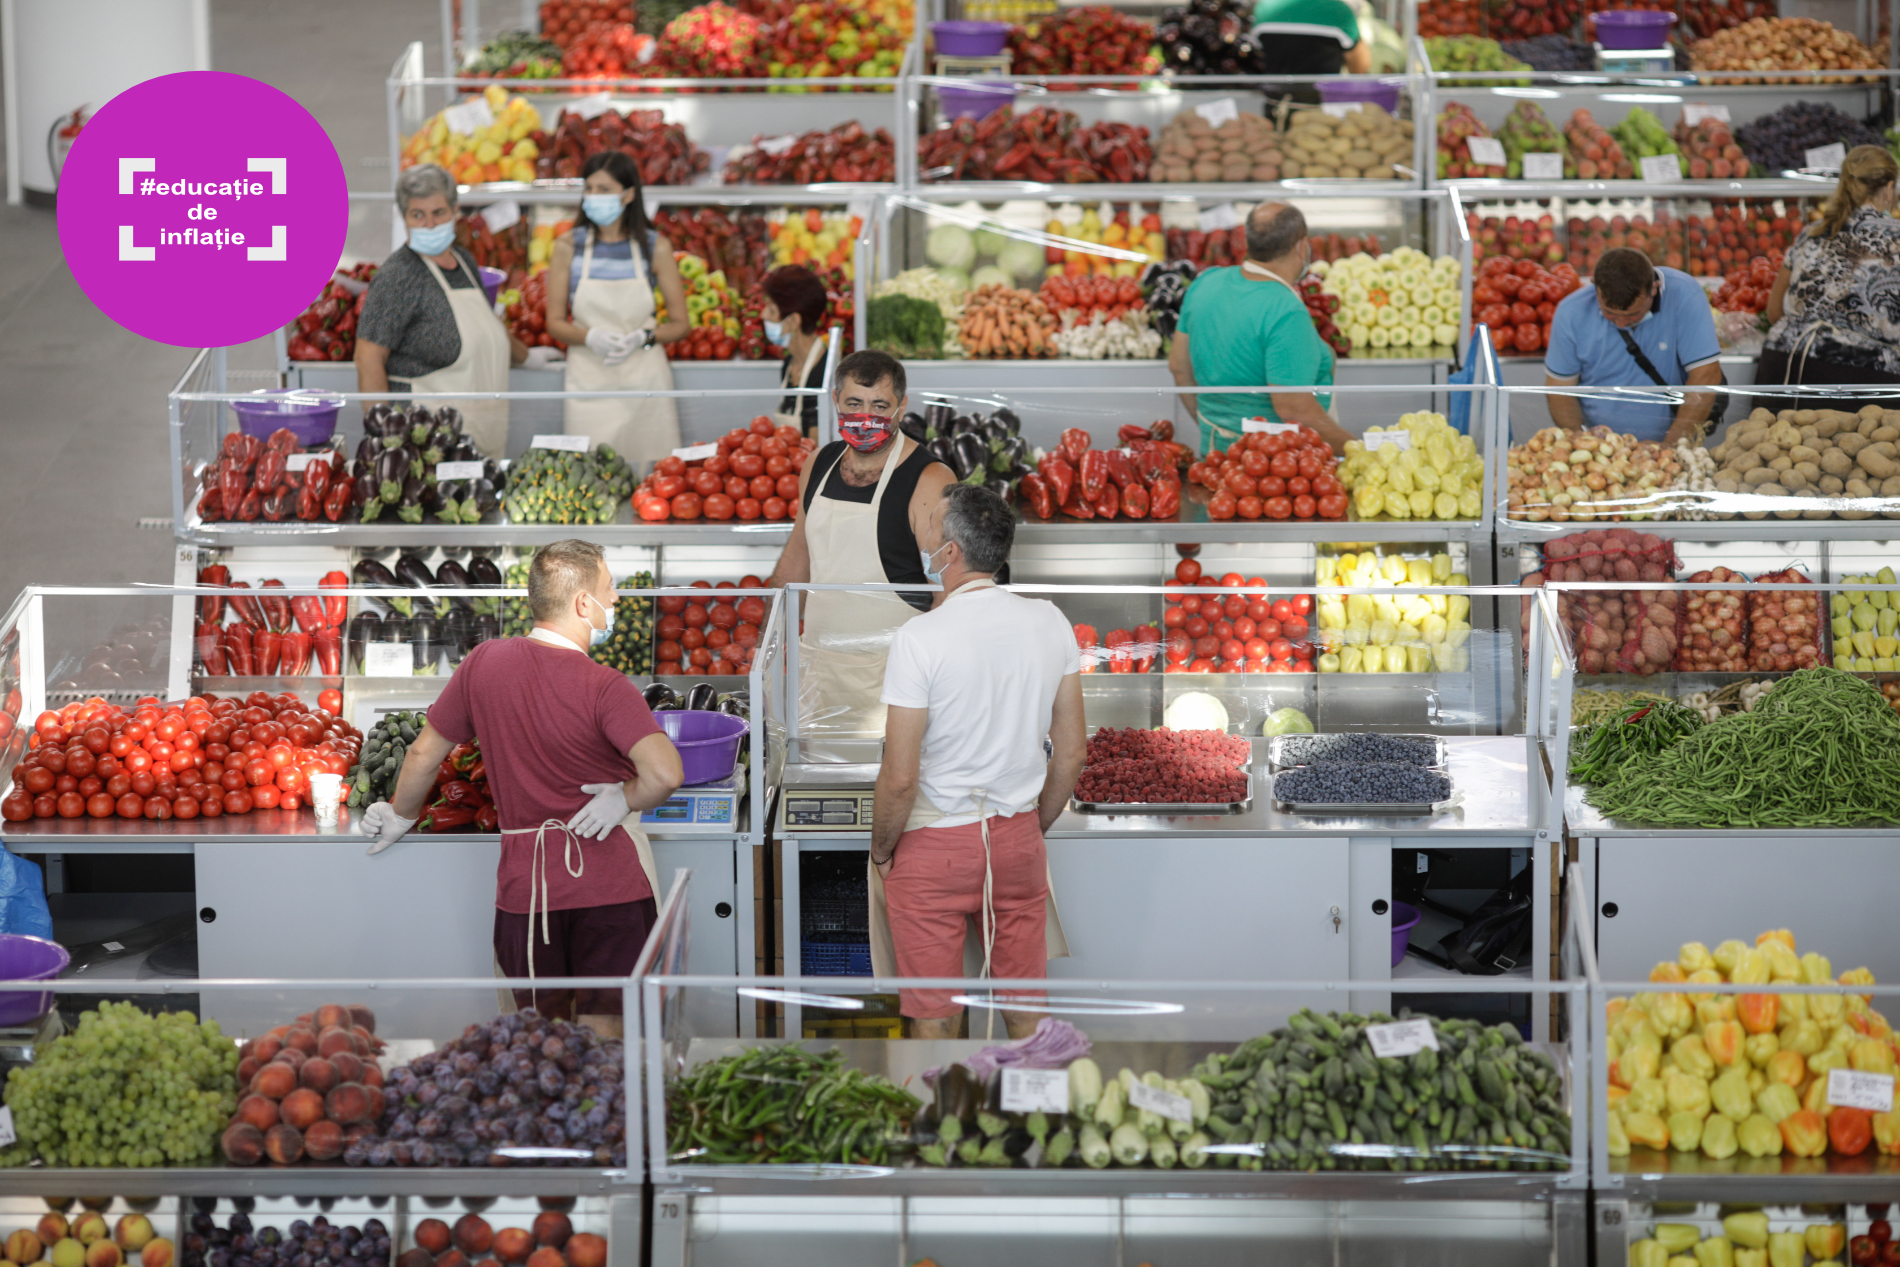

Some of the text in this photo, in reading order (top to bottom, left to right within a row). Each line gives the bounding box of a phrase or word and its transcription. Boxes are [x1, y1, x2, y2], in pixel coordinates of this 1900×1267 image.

[180, 550, 193, 561] 56
[1501, 547, 1515, 558] 54
[660, 1203, 679, 1219] 70
[1602, 1209, 1622, 1225] 69
